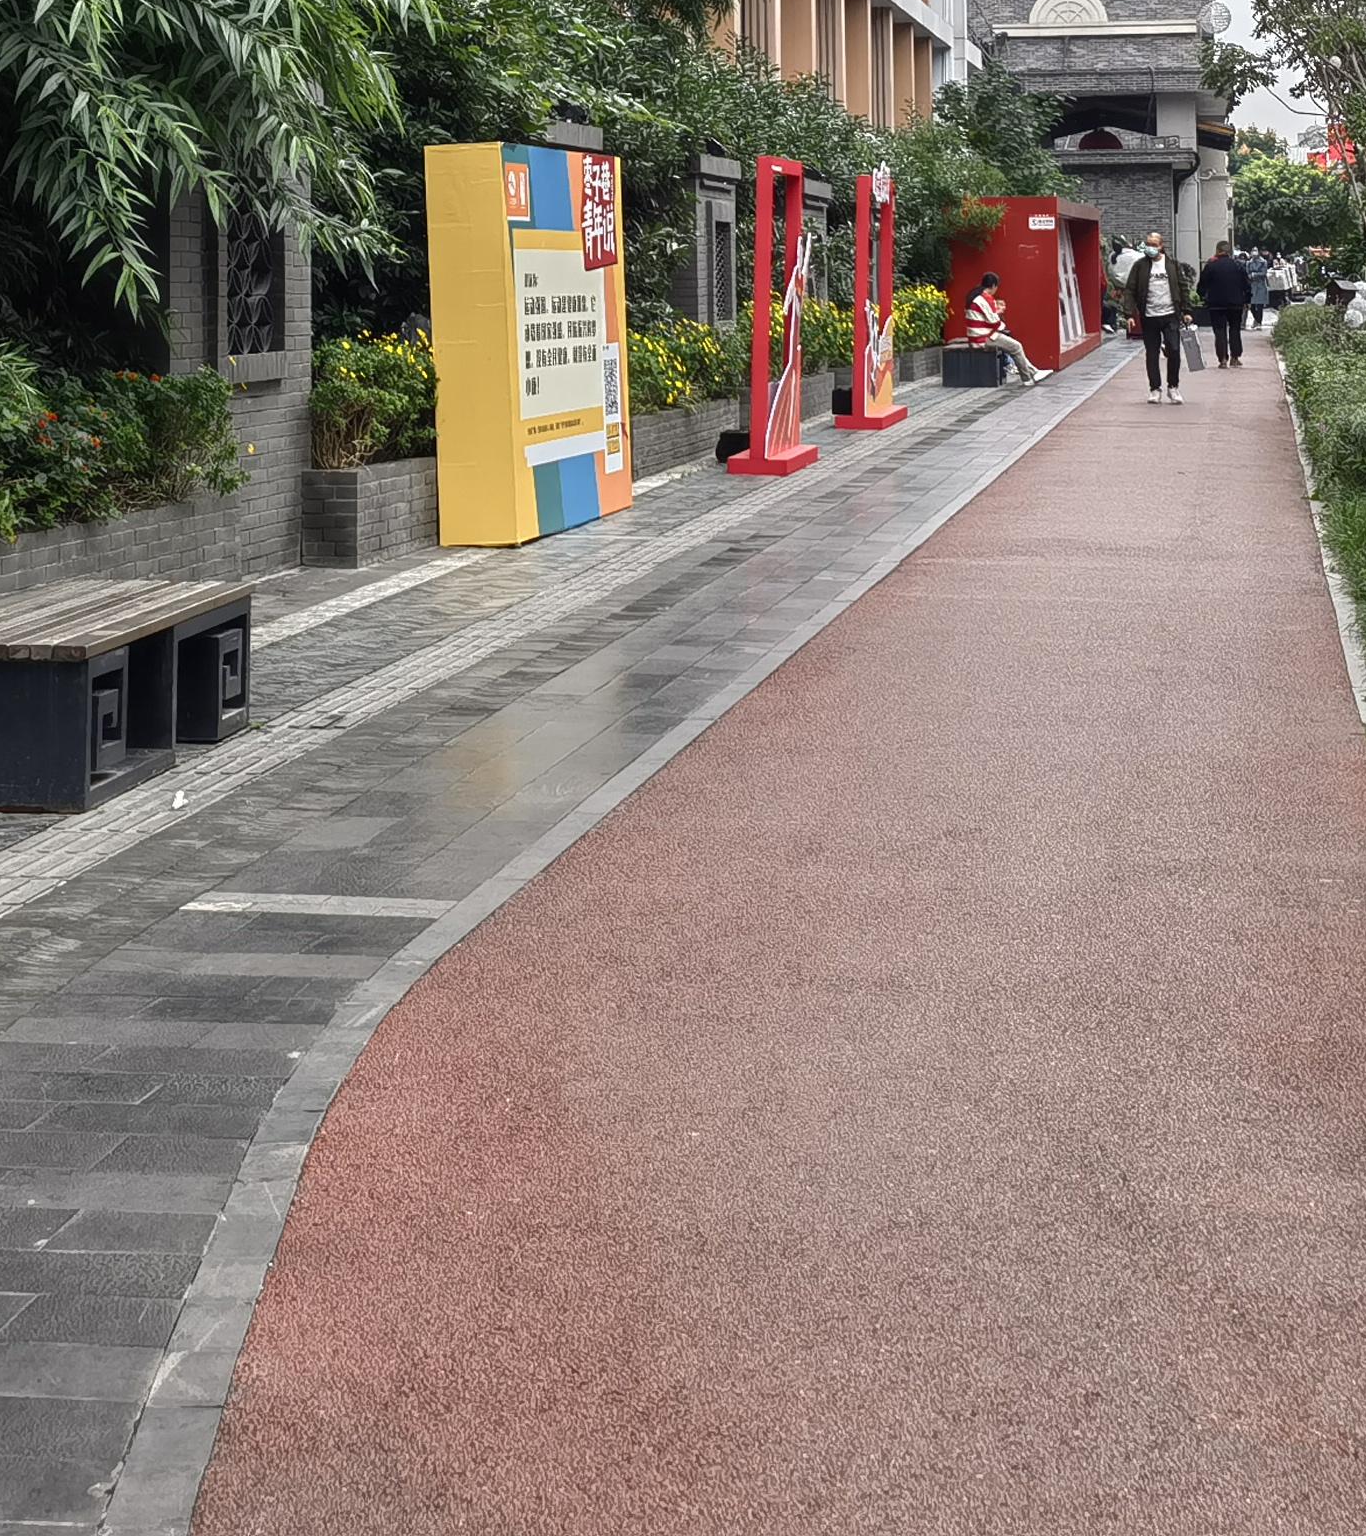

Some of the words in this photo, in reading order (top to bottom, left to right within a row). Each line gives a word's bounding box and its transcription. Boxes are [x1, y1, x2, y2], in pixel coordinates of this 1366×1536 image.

[583, 155, 611, 202] 枣子巷
[581, 198, 616, 261] 青年说
